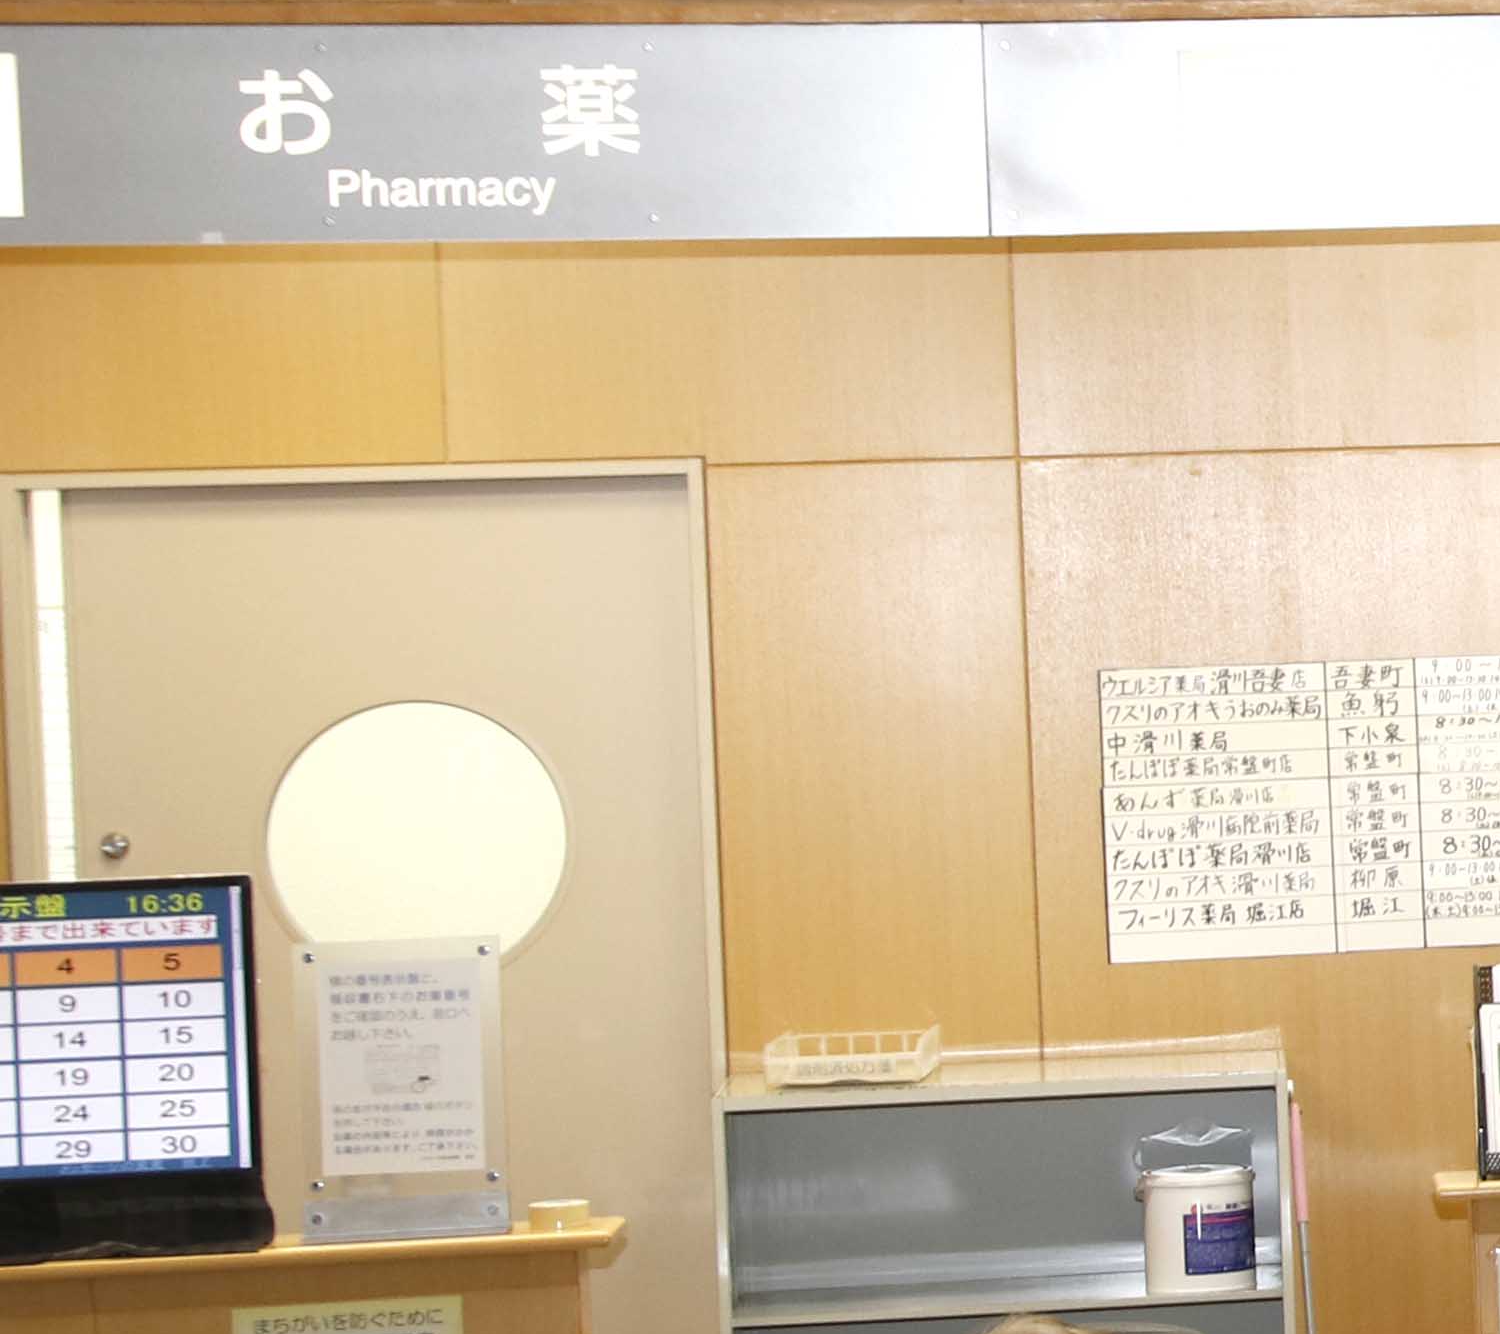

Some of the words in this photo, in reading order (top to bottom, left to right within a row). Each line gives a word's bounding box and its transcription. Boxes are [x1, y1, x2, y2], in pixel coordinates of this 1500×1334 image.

[237, 66, 642, 157] お薬
[328, 169, 557, 216] Pharmacy
[1331, 663, 1404, 690] 吾妻町
[1107, 728, 1229, 757] 中滑川薬局
[1338, 722, 1406, 746] 下小泉
[126, 892, 204, 914] 16:36
[56, 957, 75, 974] 4
[162, 952, 181, 971] 5
[59, 994, 76, 1013] 9
[158, 989, 192, 1008] 10
[54, 1031, 87, 1048] 14
[159, 1026, 194, 1044] 15
[55, 1068, 89, 1086] 19
[158, 1063, 195, 1082] 20
[54, 1105, 90, 1123] 24
[159, 1100, 196, 1118] 25
[55, 1140, 92, 1159] 29
[161, 1135, 197, 1154] 30
